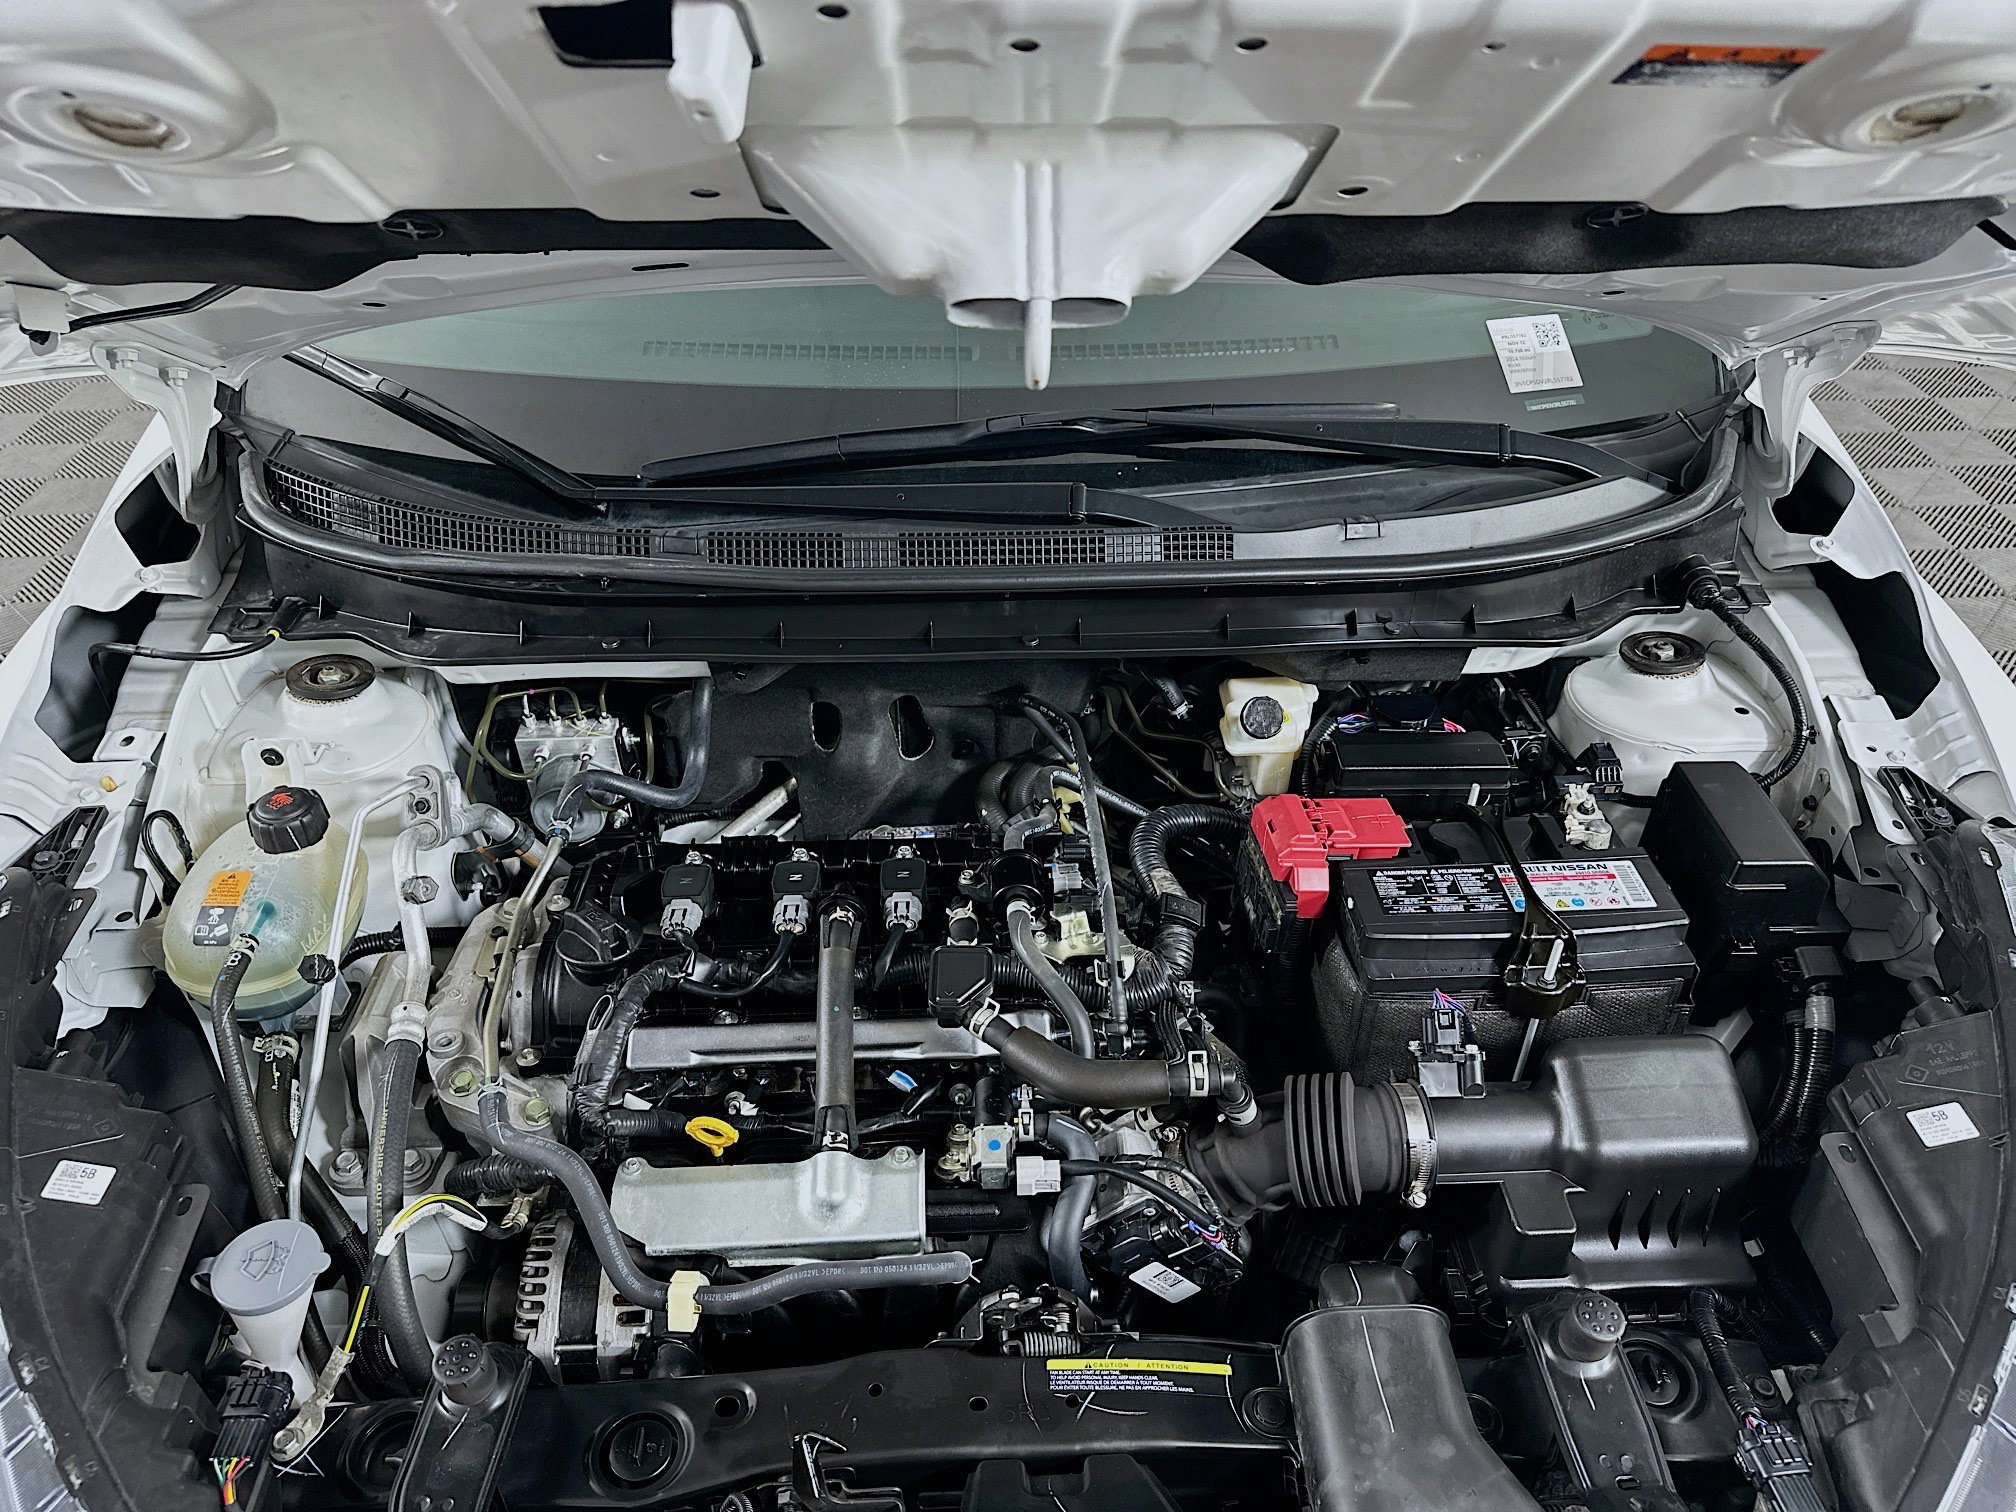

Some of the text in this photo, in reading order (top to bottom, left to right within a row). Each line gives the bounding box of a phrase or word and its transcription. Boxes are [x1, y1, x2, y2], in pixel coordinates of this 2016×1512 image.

[1498, 864, 1548, 874] REAULT
[1552, 863, 1608, 872] NISSAN
[1930, 1110, 1948, 1122] 5B
[80, 1167, 98, 1179] 5B
